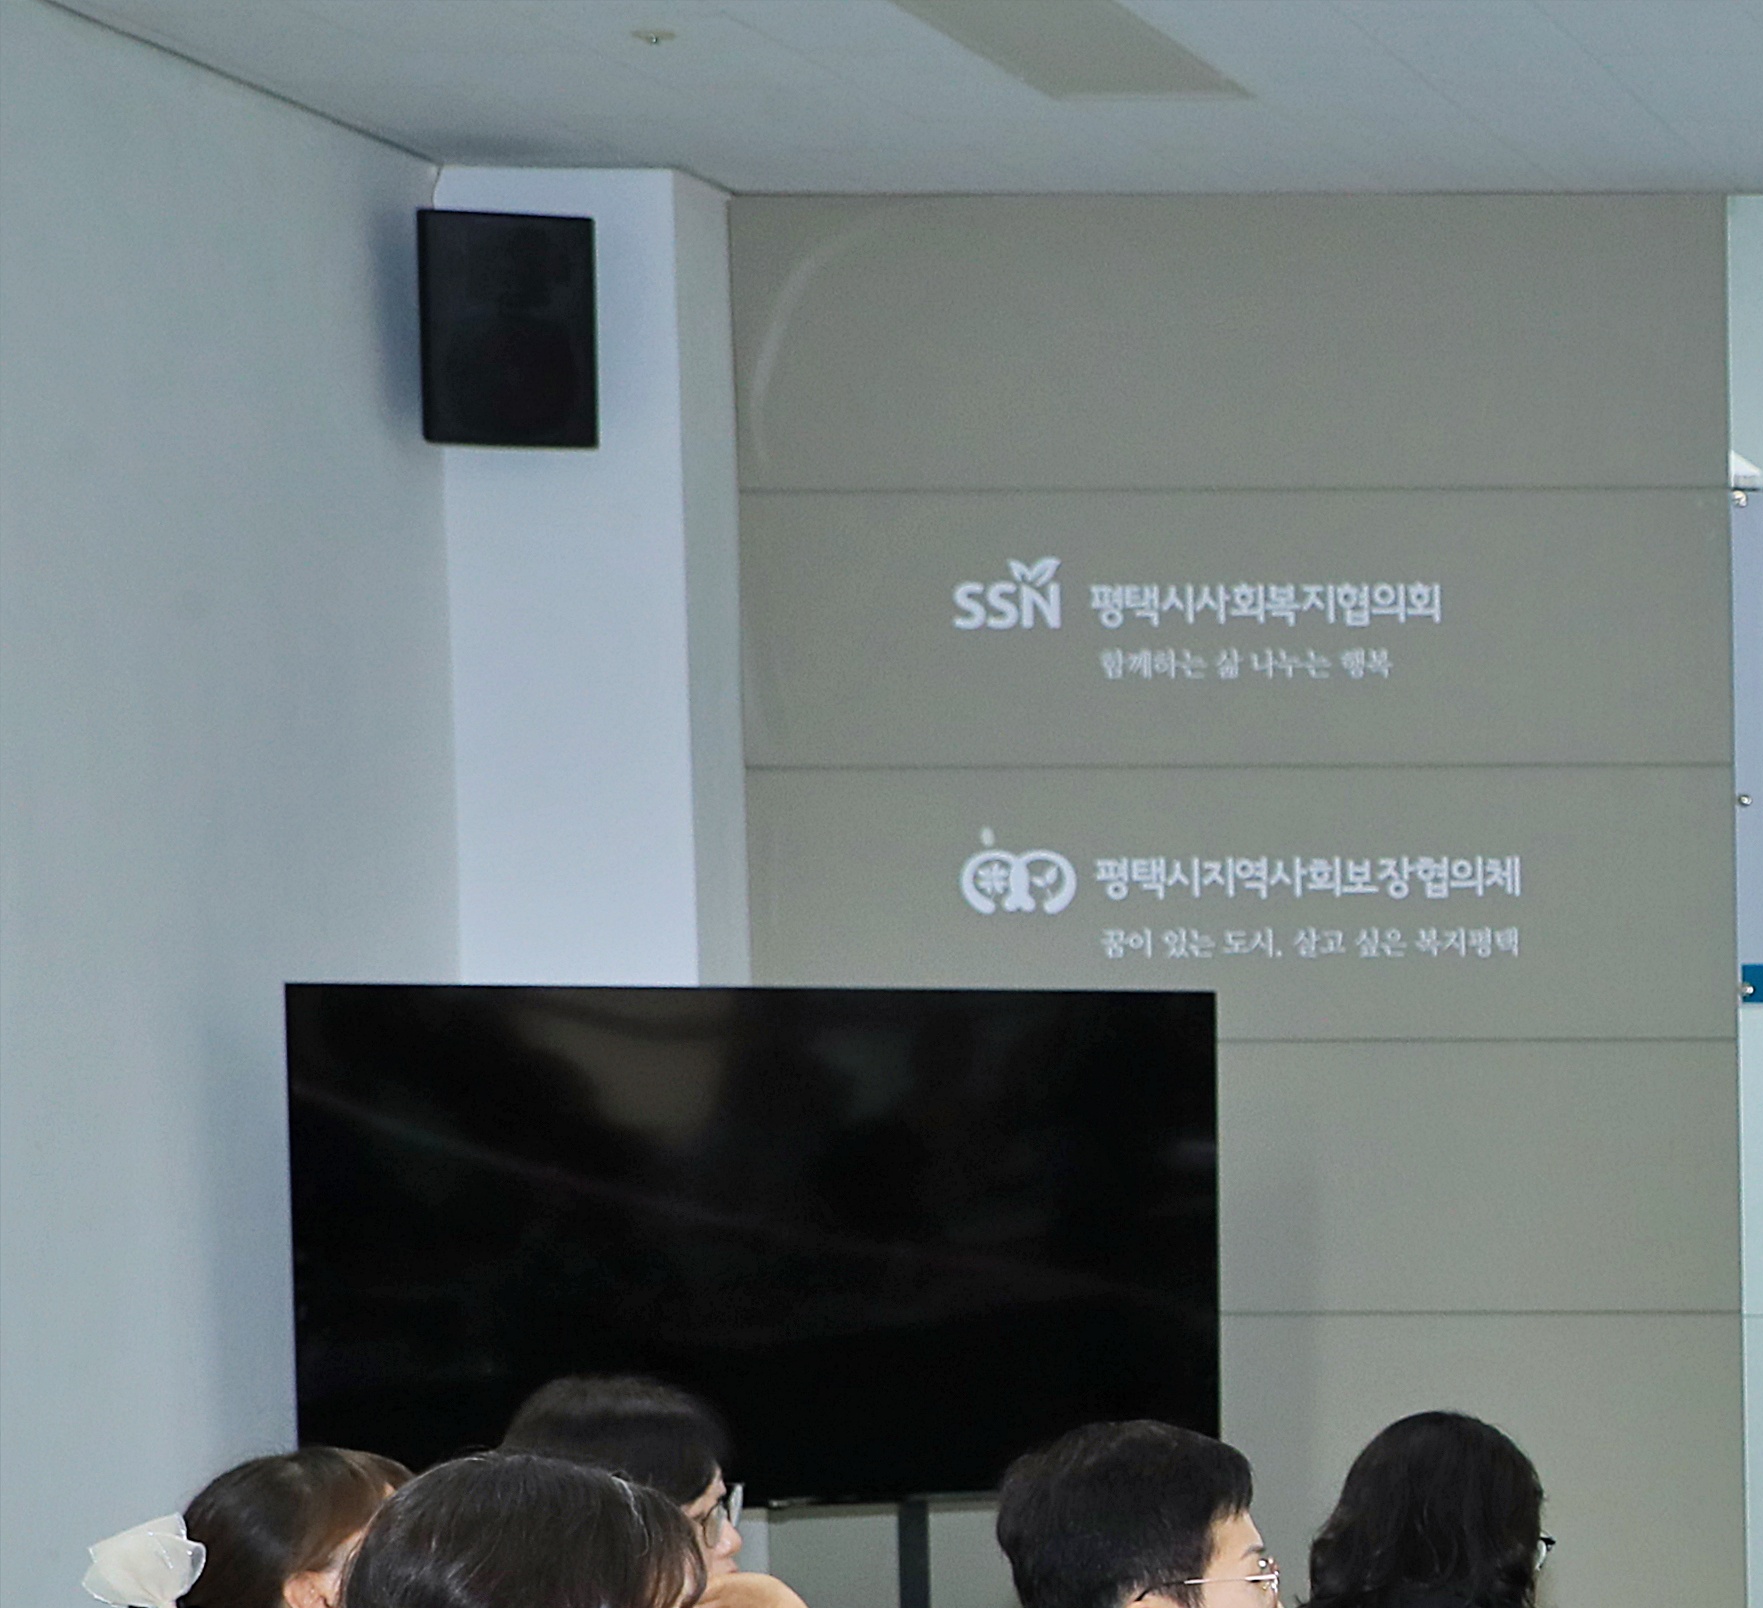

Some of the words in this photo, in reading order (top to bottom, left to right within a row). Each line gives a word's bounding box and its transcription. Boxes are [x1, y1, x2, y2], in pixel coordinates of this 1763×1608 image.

[952, 581, 1063, 630] SSN
[1090, 582, 1443, 628] 평택시사회복지협의회
[1100, 648, 1208, 680] 함께하는
[1215, 648, 1240, 680] 삶
[1251, 648, 1332, 680] 나누는
[1340, 648, 1394, 680] 행복
[1096, 855, 1523, 899] 평택시지역사회보장협의체
[1101, 929, 1154, 959] 꿈이
[1162, 929, 1216, 959] 있는
[1293, 929, 1347, 959] 살고
[1355, 929, 1408, 959] 싶은
[1415, 929, 1522, 959] 복지평택
